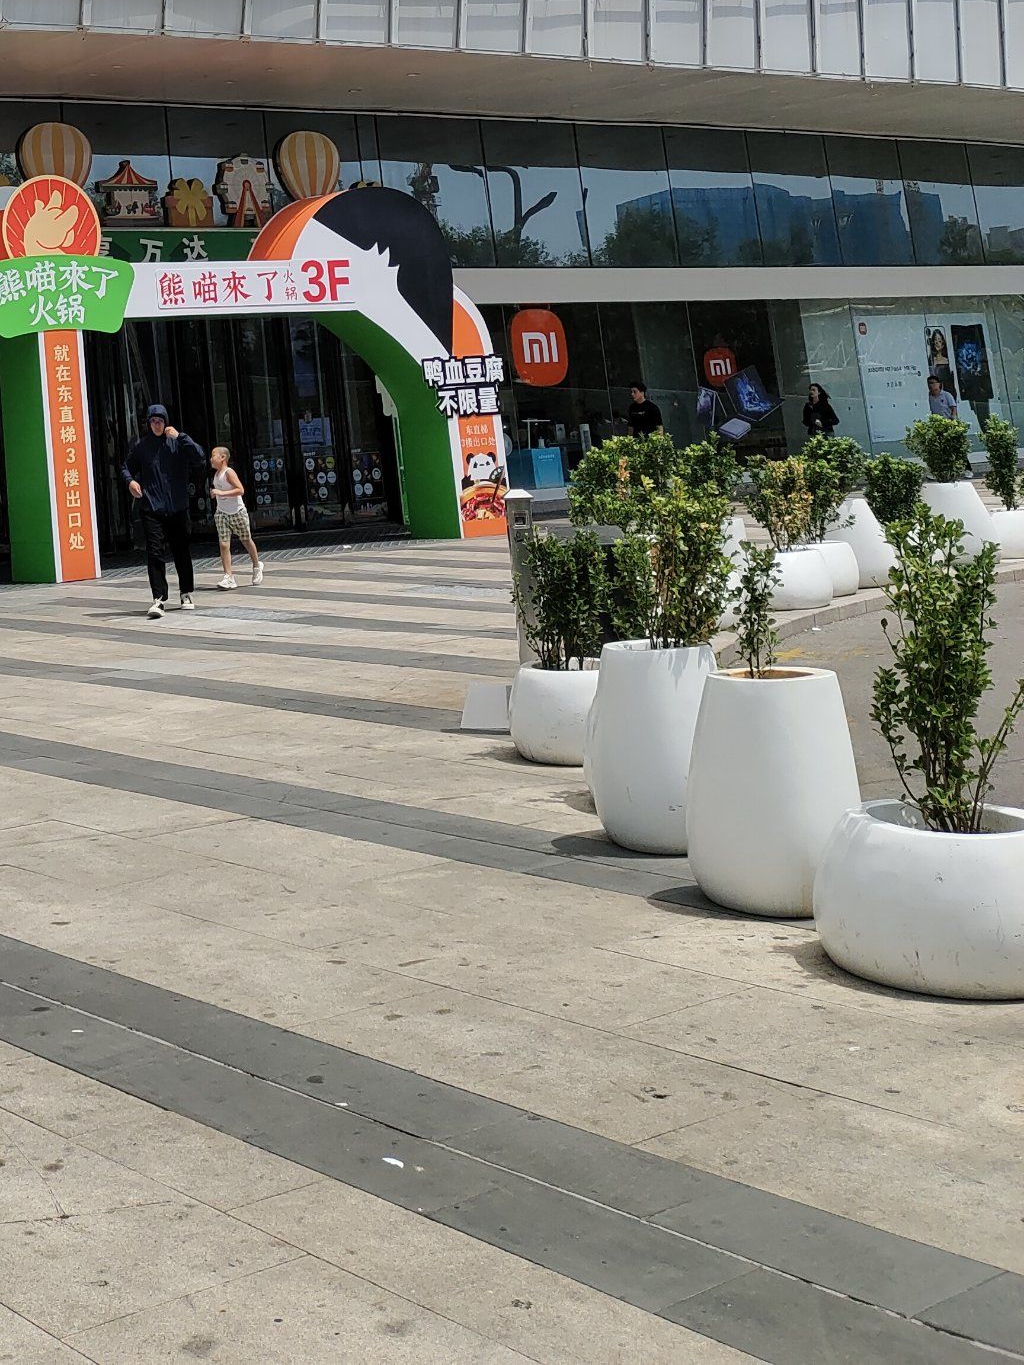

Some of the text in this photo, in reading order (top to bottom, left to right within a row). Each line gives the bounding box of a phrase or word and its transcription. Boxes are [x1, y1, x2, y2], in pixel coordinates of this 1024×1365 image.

[283, 272, 298, 301] 火锅
[300, 259, 351, 303] 3F
[29, 294, 86, 326] 火锅
[423, 356, 504, 386] 鸭血豆腐
[438, 387, 499, 416] 不限量
[53, 344, 86, 550] 就在东直梯3楼出口处
